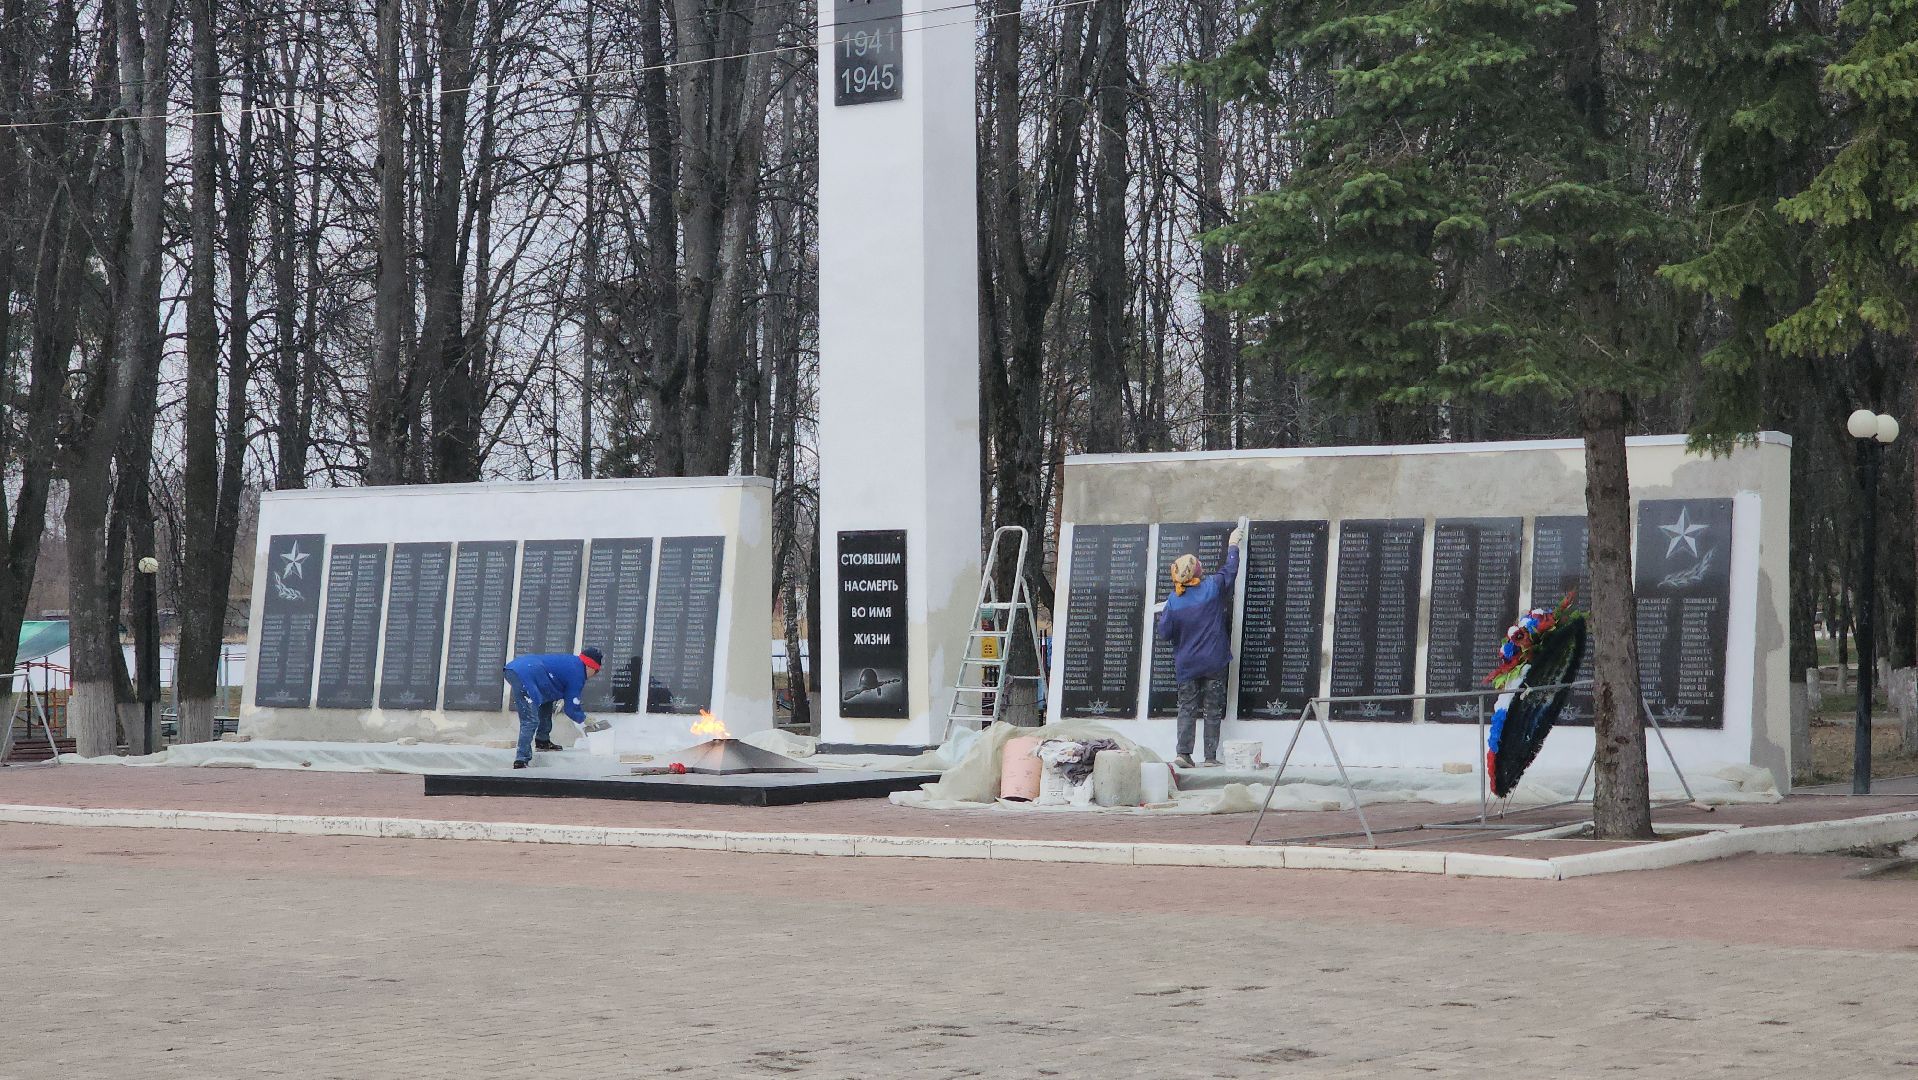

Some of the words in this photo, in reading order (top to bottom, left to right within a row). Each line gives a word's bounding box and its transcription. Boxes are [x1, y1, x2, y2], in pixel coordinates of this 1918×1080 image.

[842, 27, 894, 58] 1941
[841, 63, 894, 94] 1945
[841, 552, 901, 565] СТОЯВШИМ
[844, 579, 899, 592] НАСМЕРТЬ
[851, 606, 866, 618] ВО
[869, 606, 892, 618] ИМЯ
[853, 633, 891, 645] ЖИЗНИ
